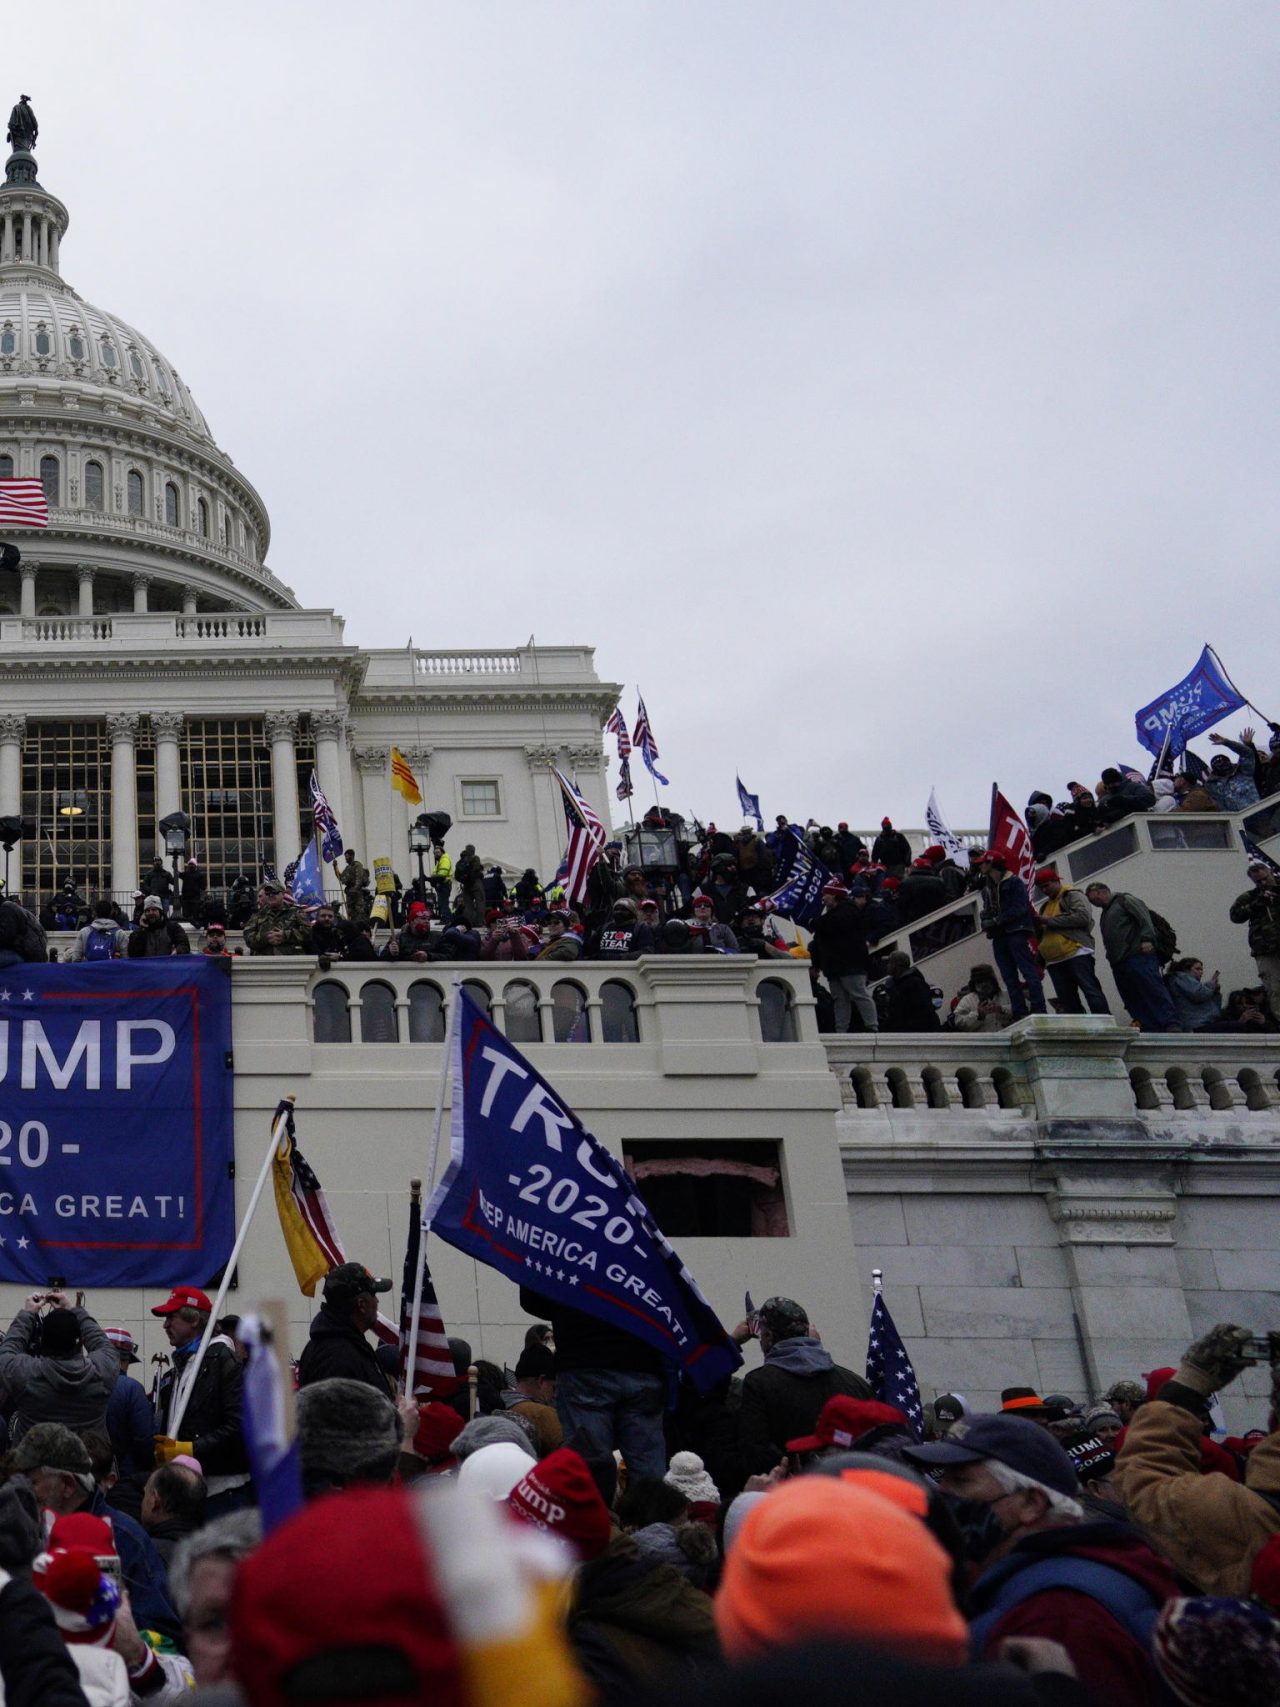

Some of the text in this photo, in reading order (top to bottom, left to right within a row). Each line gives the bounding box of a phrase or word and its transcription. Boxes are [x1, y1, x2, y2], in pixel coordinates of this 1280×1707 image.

[804, 868, 822, 903] 2020
[600, 940, 630, 949] STEAL
[601, 931, 633, 941] STOP
[54, 1194, 185, 1218] GREAT!
[505, 1216, 599, 1272] AMERICA
[605, 1263, 690, 1347] GREAT!
[1077, 1451, 1112, 1473] 2020
